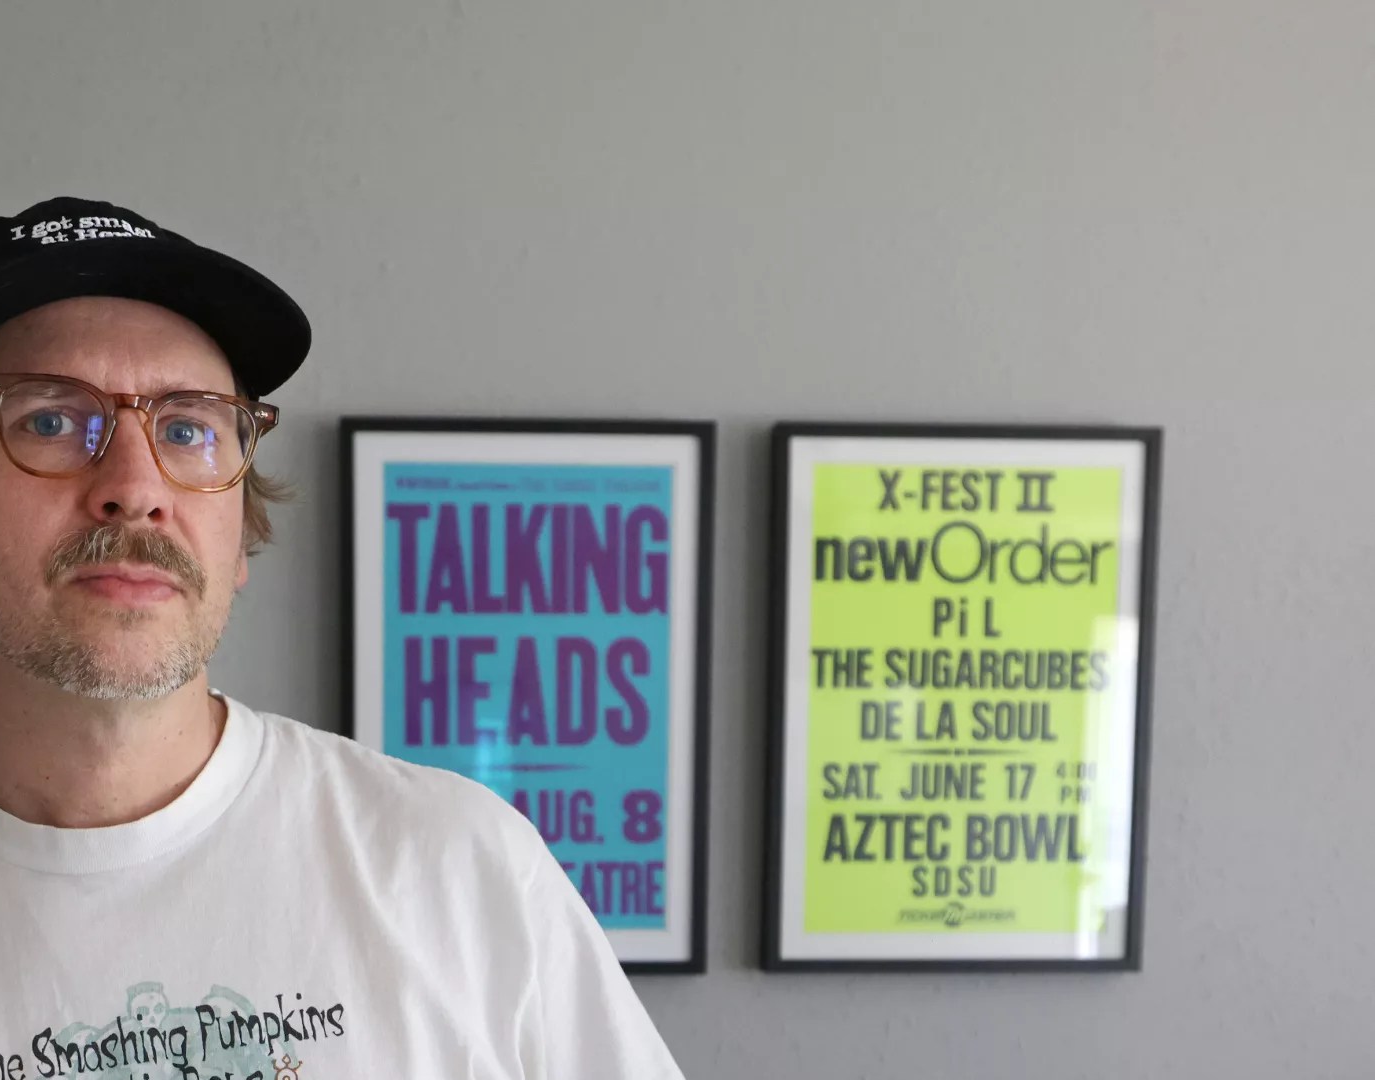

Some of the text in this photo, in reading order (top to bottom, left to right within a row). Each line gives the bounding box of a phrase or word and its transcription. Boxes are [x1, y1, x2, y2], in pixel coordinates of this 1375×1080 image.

[10, 225, 26, 241] I
[31, 216, 74, 239] got
[41, 232, 69, 245] at
[876, 470, 1056, 512] X-FEST II
[386, 503, 669, 615] TALKING
[403, 635, 652, 747] HEADS
[811, 649, 1111, 691] THE SUGARCUBES
[860, 702, 1058, 742] DE LA SOUL
[822, 763, 882, 801] SAT.
[900, 763, 986, 801] JUNE
[1005, 763, 1037, 801] 17
[622, 789, 662, 844] 8
[823, 812, 1087, 864] AZTEC BOWL
[562, 861, 665, 916] ATRE
[912, 866, 997, 897] SDSU
[32, 1013, 188, 1079] Smashing
[195, 993, 346, 1060] Pumpkins
